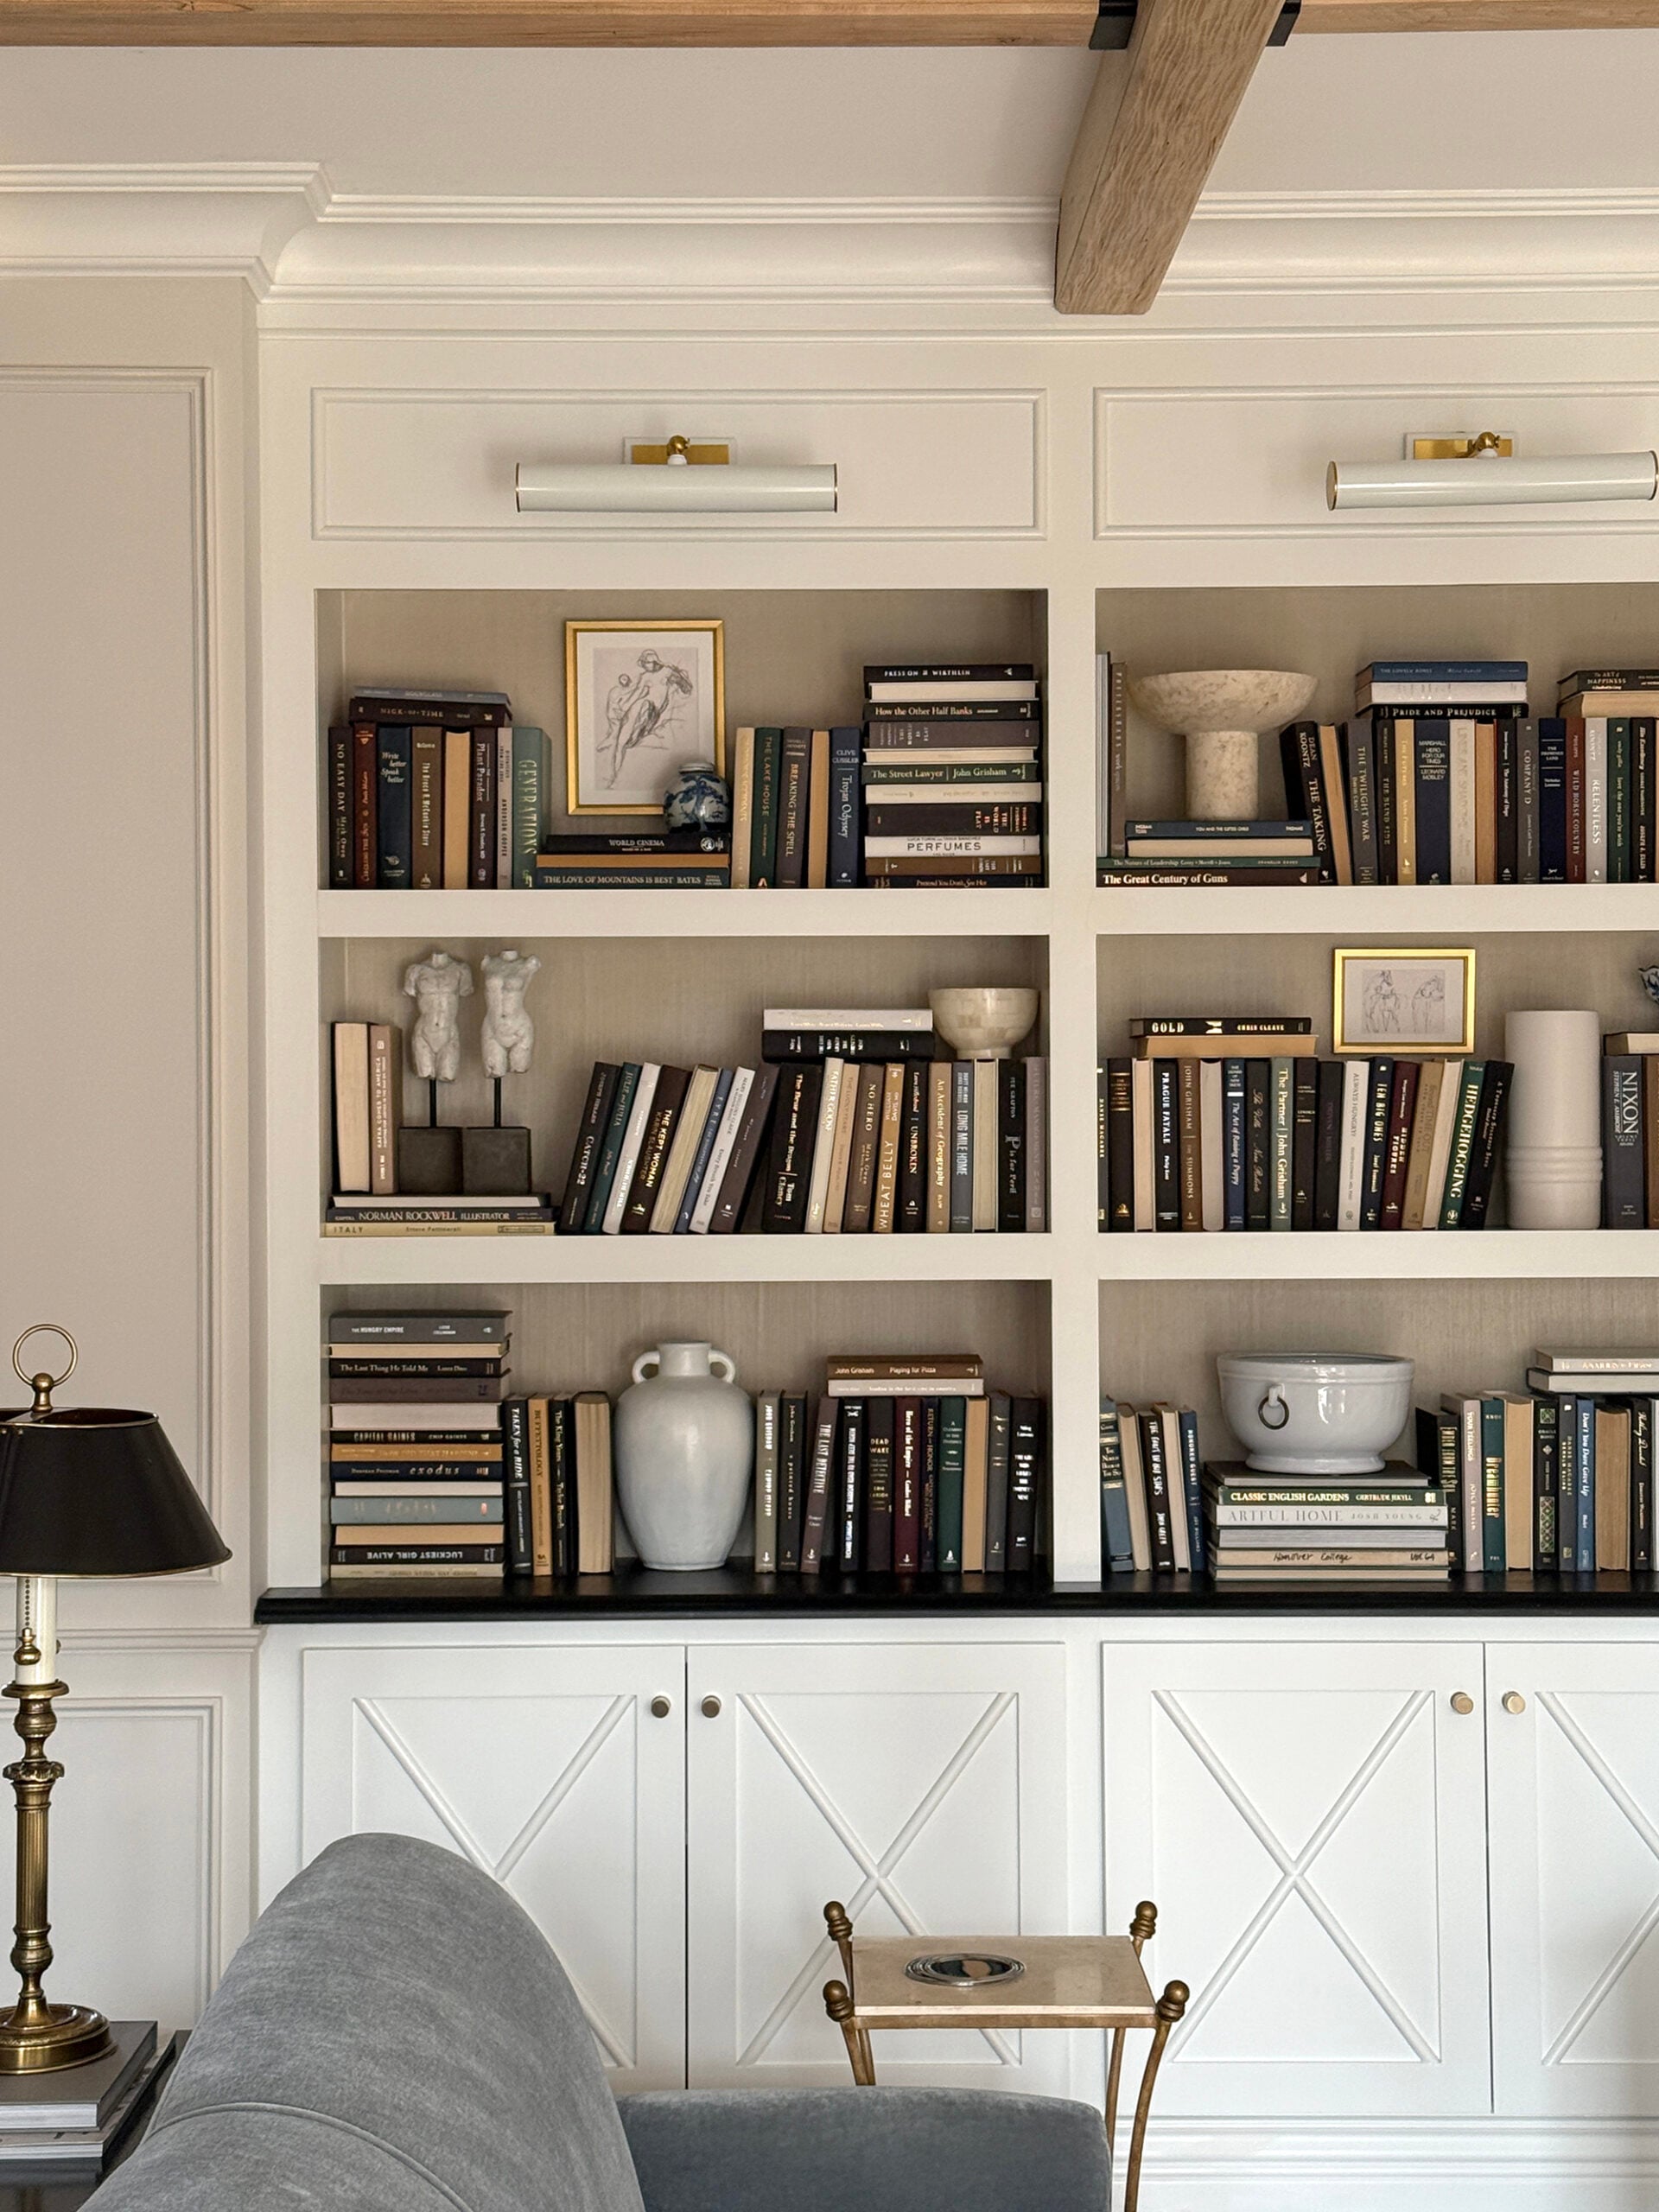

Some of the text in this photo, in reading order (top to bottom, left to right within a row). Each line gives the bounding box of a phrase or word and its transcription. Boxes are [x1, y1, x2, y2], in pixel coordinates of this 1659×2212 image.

[875, 707, 893, 715] How
[894, 707, 906, 715] the
[908, 707, 930, 715] Other
[931, 707, 949, 715] Half
[950, 707, 973, 715] Banks
[337, 744, 345, 758] NO
[1299, 732, 1311, 768] KOONTZ
[1308, 737, 1317, 760] DEAN
[1357, 747, 1366, 765] THE
[476, 743, 486, 802] Plant Paradox
[763, 757, 772, 782] LAKE
[889, 769, 912, 778] Street
[915, 769, 944, 779] Lawyer
[953, 767, 1007, 779] John Grisham
[1523, 749, 1532, 794] COMPANY
[838, 775, 852, 838] Trojan Odyssey
[1358, 768, 1369, 816] TWILIGHT
[518, 760, 537, 855] GENERATIONS
[785, 764, 798, 857] BREAKING THE SPELL
[1308, 779, 1326, 851] THE TAKING
[1592, 779, 1601, 844] RELENTLESS
[907, 842, 982, 851] PERFUMES
[544, 875, 561, 884] THE
[562, 875, 582, 884] LOVE
[584, 875, 596, 884] OF
[597, 875, 645, 884] MOUNTAINS
[645, 875, 653, 884] IS
[654, 875, 673, 884] BEST
[677, 875, 701, 884] BATES
[1103, 874, 1228, 885] The Great Century of Guns
[1152, 1022, 1185, 1033] GOLD
[937, 1079, 945, 1090] An
[1278, 1068, 1288, 1126] The Partner
[824, 1071, 839, 1131] FATHER GOOSE
[865, 1084, 876, 1131] NO HERO
[937, 1093, 945, 1129] Accident
[1161, 1072, 1171, 1143] PRAGUE FATALE
[1373, 1084, 1388, 1142] TEN BIG ONES
[1622, 1071, 1639, 1135] NIXON
[645, 1109, 672, 1188] THE KEPT WOMAN
[910, 1125, 918, 1174] UNBROKEN
[957, 1110, 968, 1175] LONG MILE HOME
[1005, 1135, 1021, 1149] P
[1450, 1084, 1478, 1198] HEDGEHOGGING
[576, 1135, 594, 1185] CATCH-22
[935, 1140, 945, 1186] Geography
[1277, 1133, 1287, 1198] John Grisham
[775, 1176, 786, 1206] Clancy
[785, 1182, 795, 1202] Tom
[879, 1140, 893, 1230] WHEAT BELLY
[359, 1211, 404, 1221] NORMAN
[405, 1211, 457, 1221] ROCKWELL
[460, 1211, 511, 1220] ILLUSTRATOR
[512, 1408, 520, 1435] TAKEN
[1149, 1421, 1158, 1434] THE
[1581, 1412, 1590, 1433] Don't
[512, 1437, 521, 1447] for
[903, 1446, 912, 1468] Empire
[410, 1465, 460, 1476] exodus
[513, 1456, 522, 1478] RIDE
[813, 1424, 832, 1494] THE LAST DETECTIVE
[1230, 1492, 1350, 1501] CLASSIC ENGLISH GARDENS
[1485, 1457, 1503, 1518] Dreamhunter
[1580, 1485, 1589, 1496] Up
[1228, 1510, 1344, 1521] ARTFUL HOME
[1273, 1553, 1352, 1561] Hanover College
